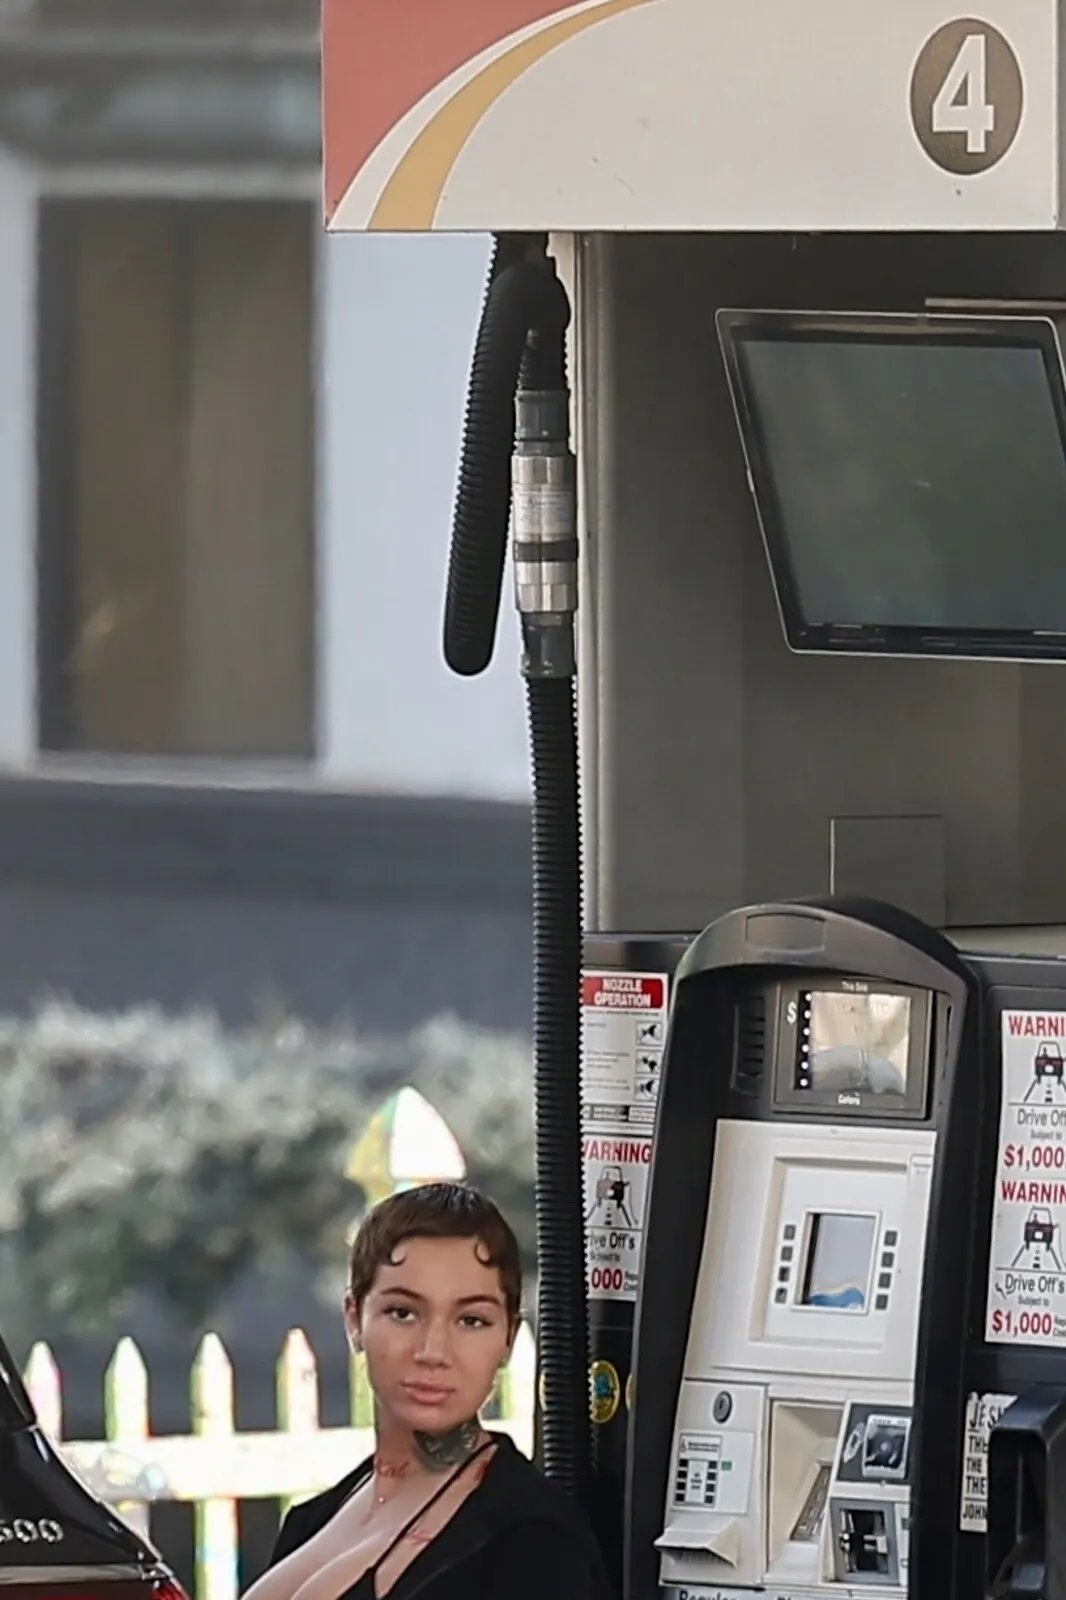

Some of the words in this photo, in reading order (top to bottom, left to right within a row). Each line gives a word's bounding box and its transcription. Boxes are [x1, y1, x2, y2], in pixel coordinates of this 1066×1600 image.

[932, 34, 995, 153] 4
[602, 978, 643, 993] NOZZLE
[594, 993, 651, 1007] OPERATION
[1017, 1108, 1047, 1126] Drive
[583, 1138, 652, 1164] ARNING
[1003, 1144, 1064, 1172] $1,000
[609, 1232, 635, 1250] Off's
[1005, 1273, 1035, 1293] Drive
[1038, 1275, 1065, 1294] Off's
[992, 1308, 1052, 1337] $1,000
[966, 1456, 982, 1473] THE
[965, 1475, 986, 1495] THE
